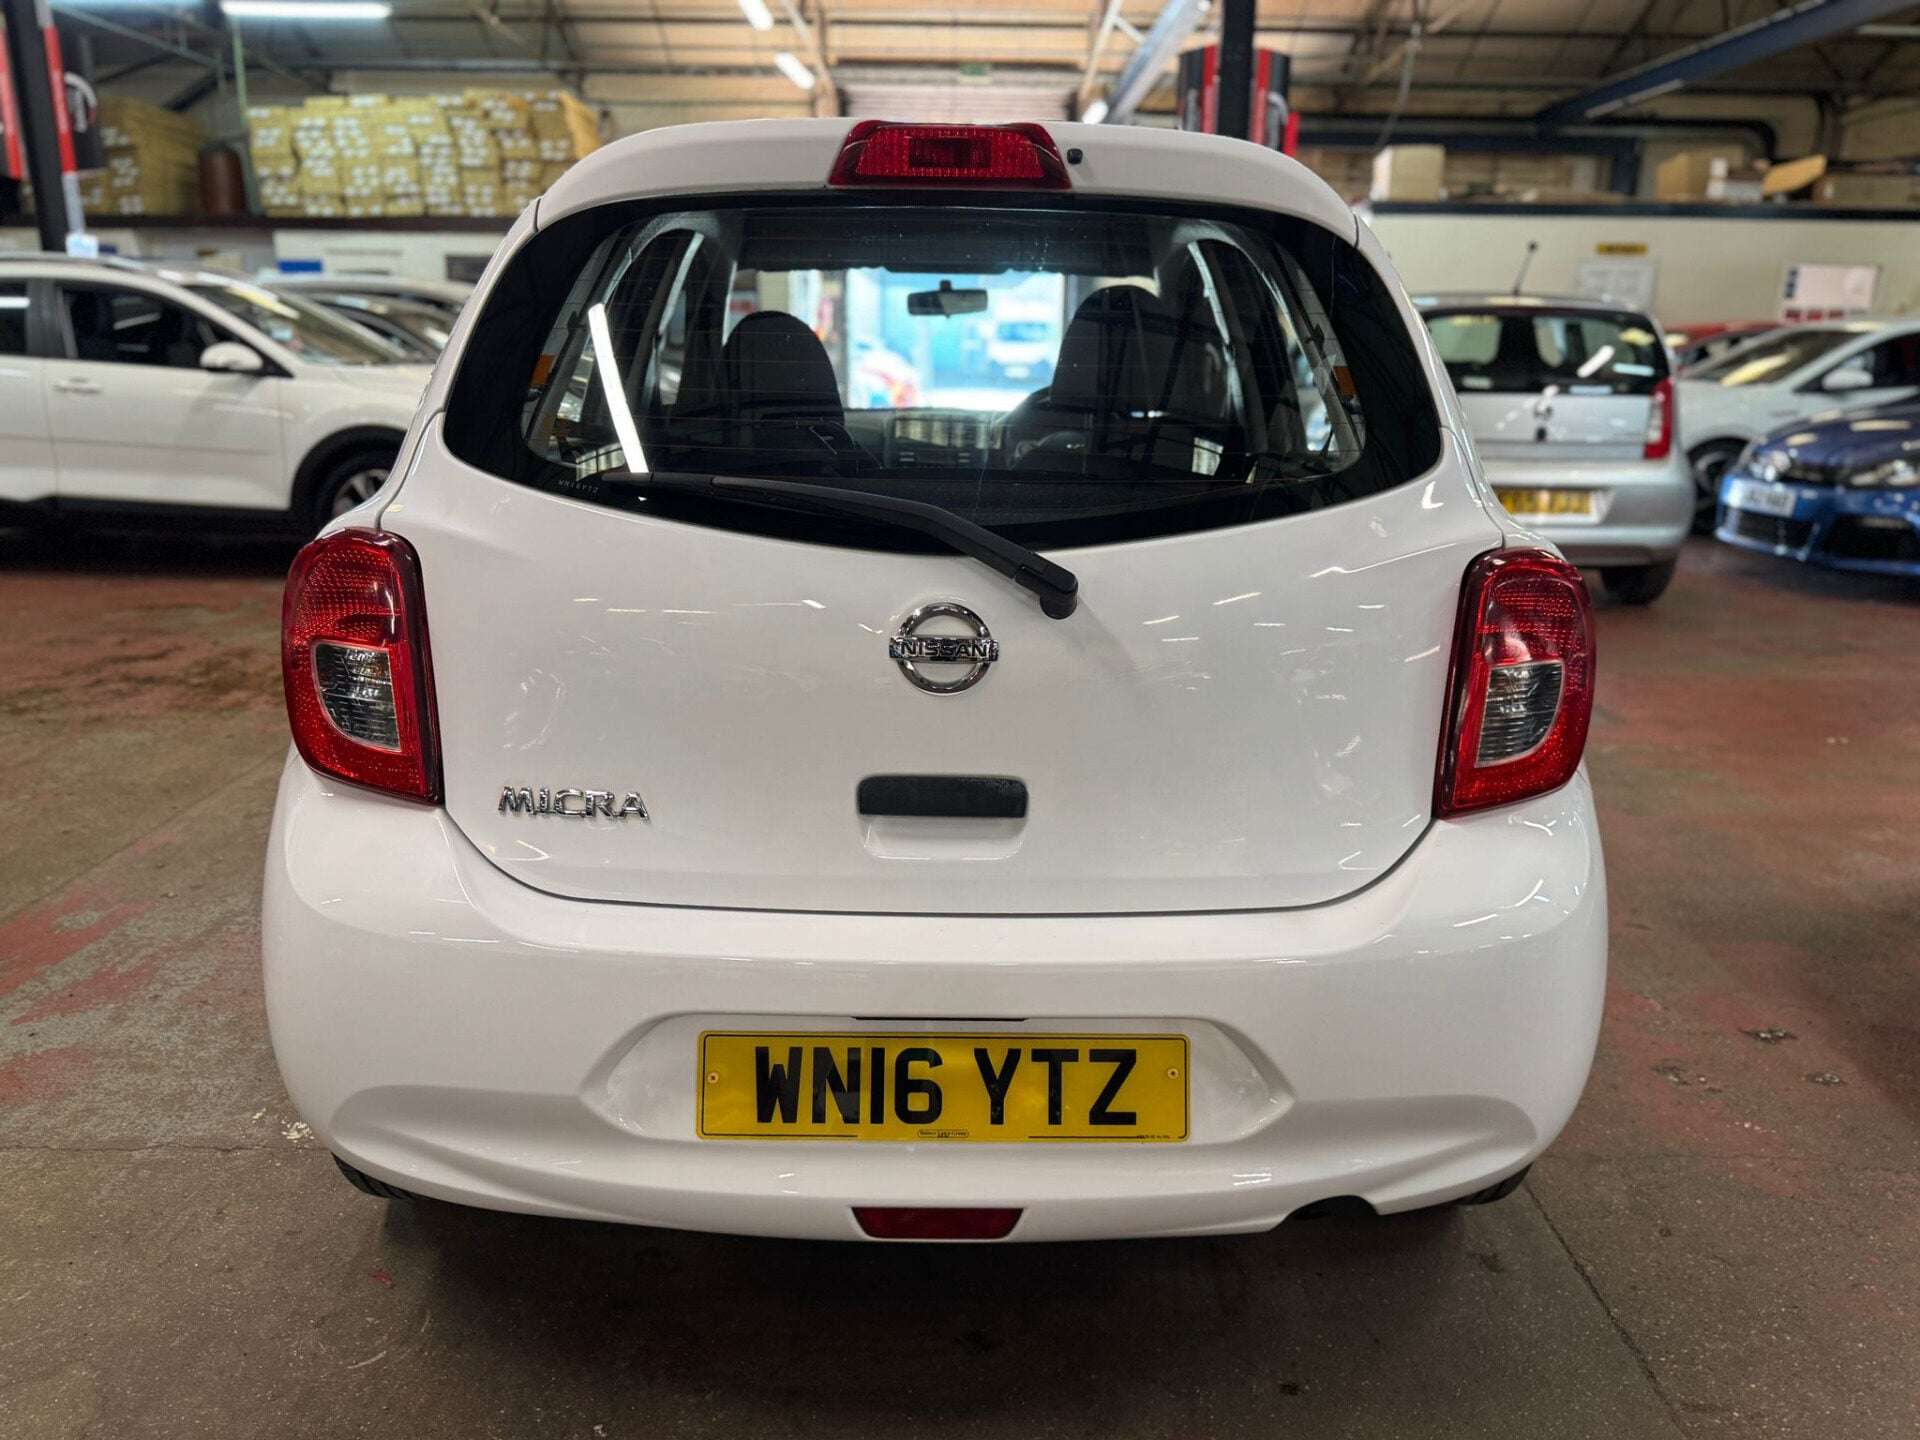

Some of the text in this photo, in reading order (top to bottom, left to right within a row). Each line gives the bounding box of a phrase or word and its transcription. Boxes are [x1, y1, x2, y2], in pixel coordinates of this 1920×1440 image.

[900, 640, 987, 657] NISSAN
[498, 786, 650, 818] MICRA
[755, 1046, 1137, 1126] WN16 YTZ
